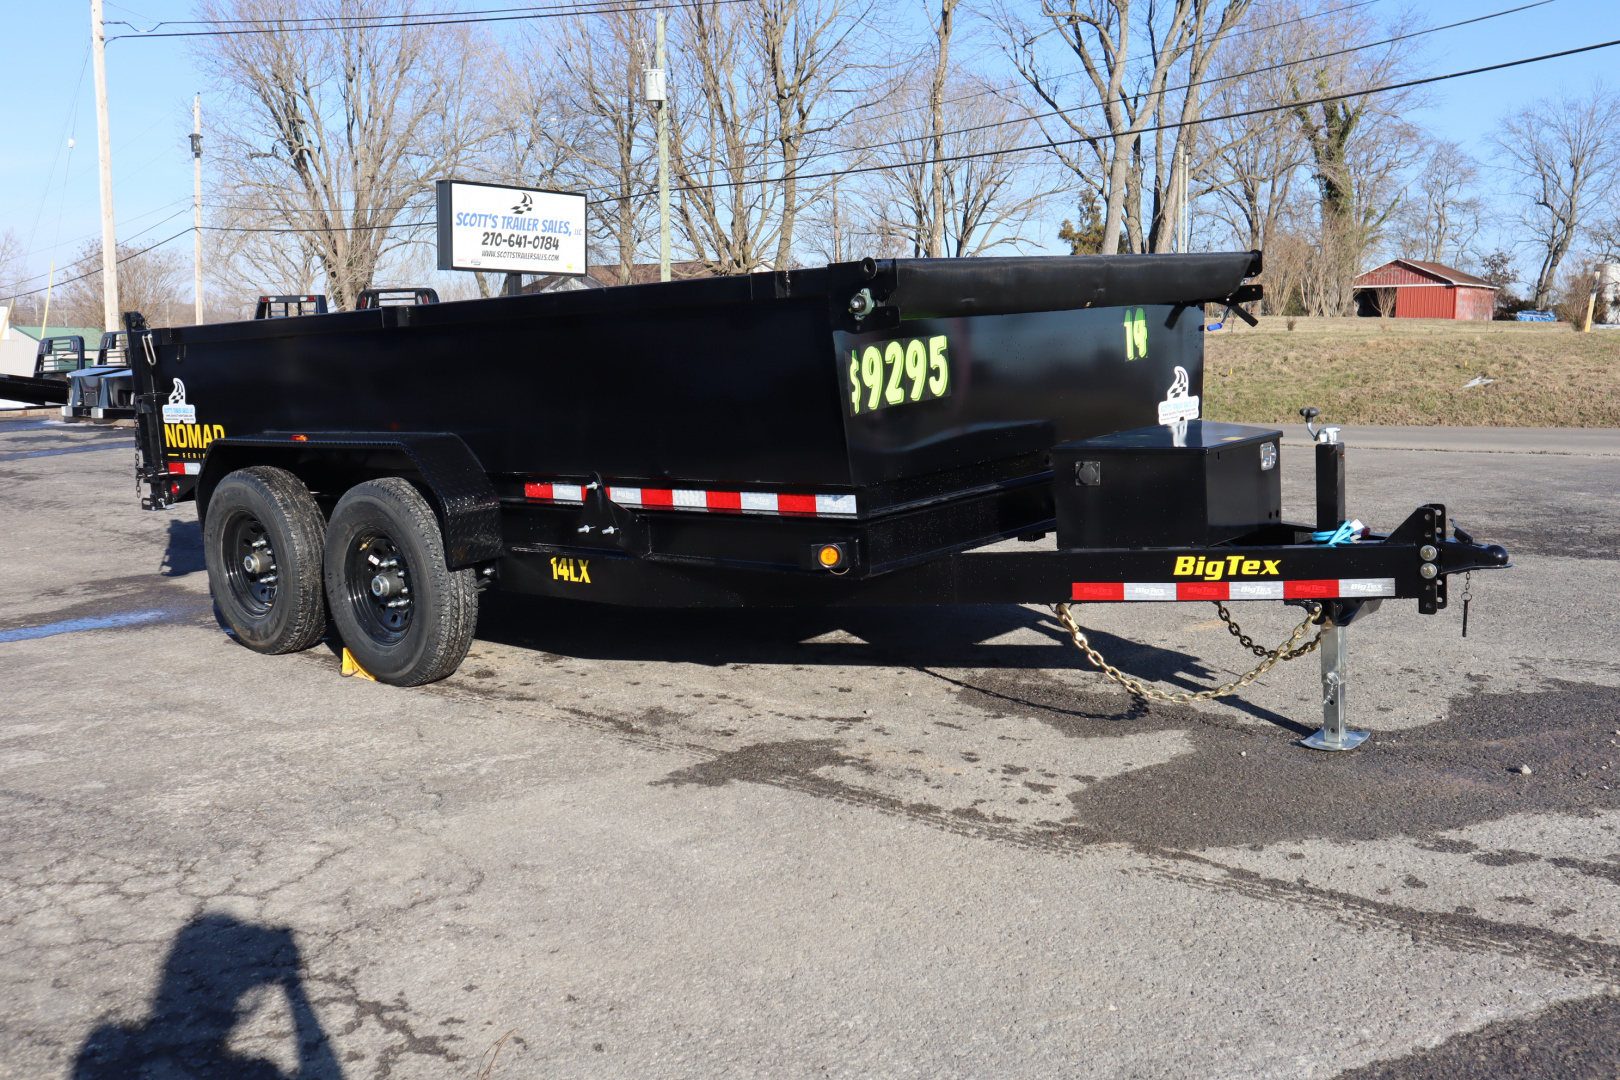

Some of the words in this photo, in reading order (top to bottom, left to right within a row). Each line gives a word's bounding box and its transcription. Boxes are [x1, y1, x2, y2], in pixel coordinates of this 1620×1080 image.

[456, 212, 498, 229] SCOTT'S
[501, 216, 538, 231] TRAILER
[541, 219, 572, 236] SALES,
[481, 232, 559, 251] 270-641-0784
[481, 250, 560, 261] WWW.SCOTTSTRAILERSALES.COM
[850, 335, 948, 413] $9295
[551, 557, 591, 583] 14LX
[1173, 555, 1281, 581] BigTex
